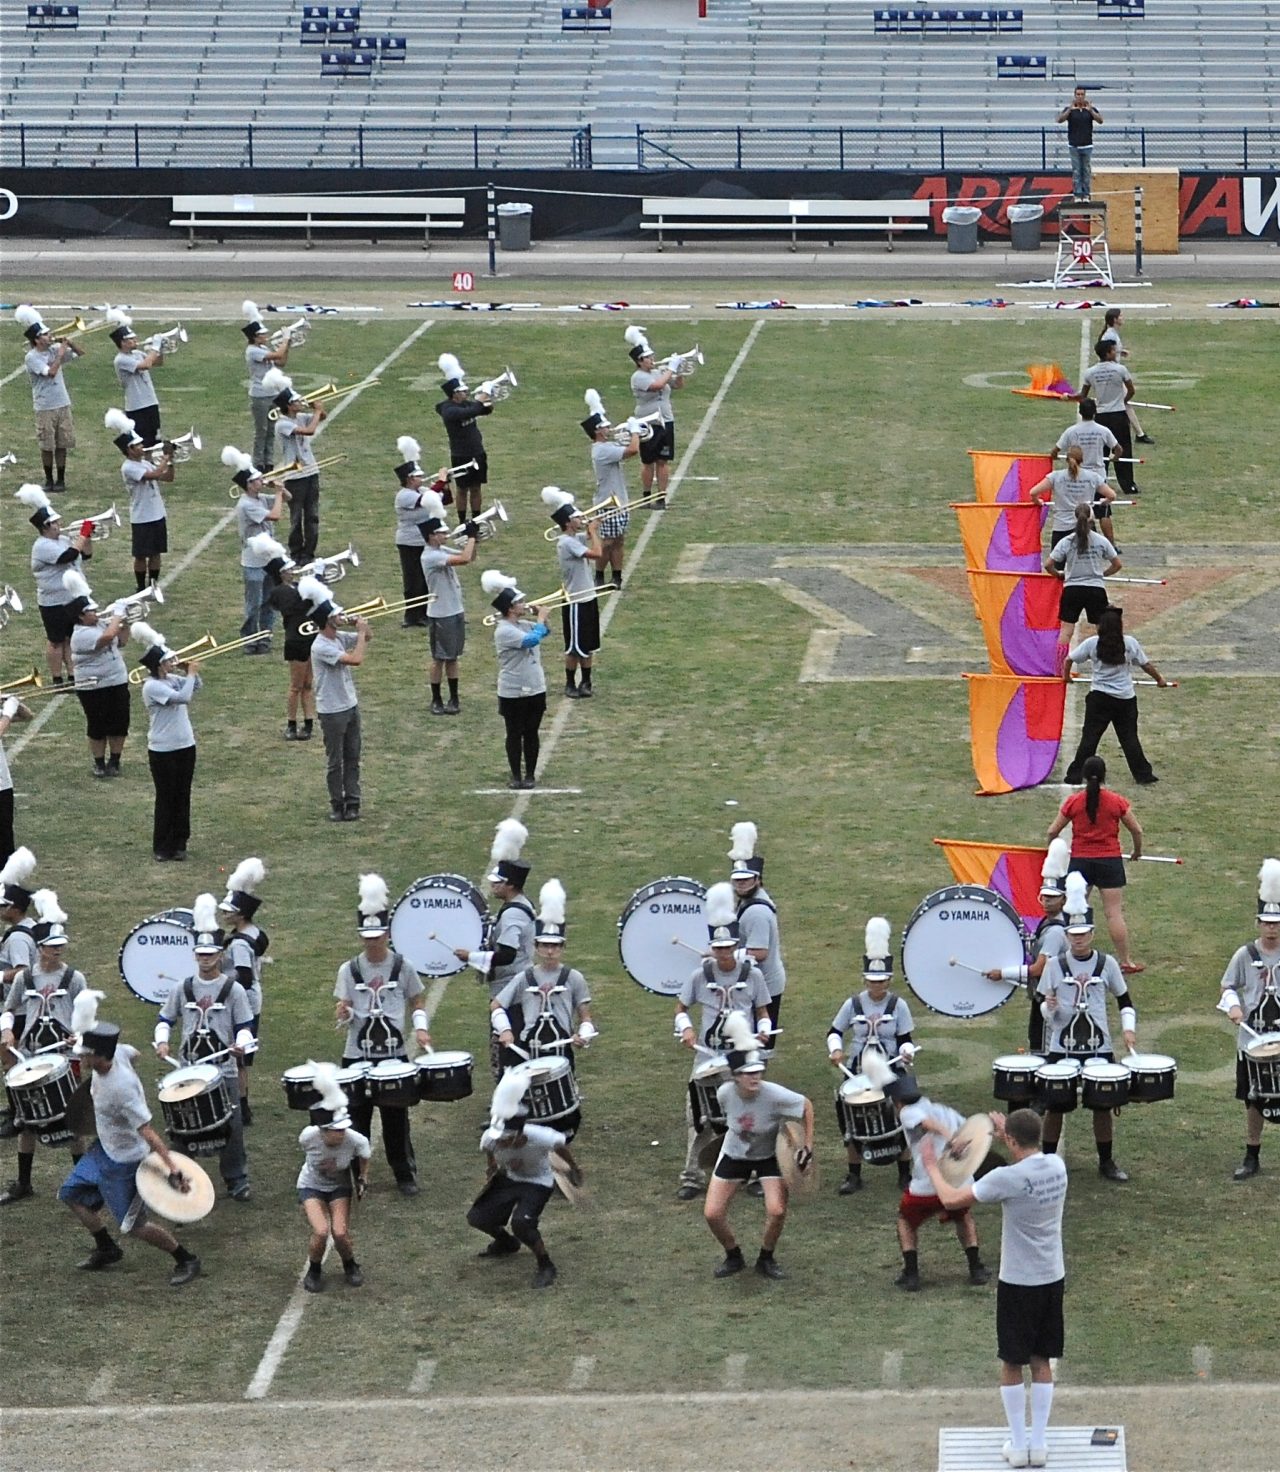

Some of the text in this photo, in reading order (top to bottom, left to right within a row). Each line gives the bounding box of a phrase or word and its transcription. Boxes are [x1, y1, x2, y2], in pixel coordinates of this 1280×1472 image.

[889, 177, 1242, 235] ARIZA
[1073, 240, 1091, 257] 50
[453, 272, 472, 290] 40
[422, 898, 462, 909] YAMAHA
[661, 903, 702, 914] YAMAHA
[950, 910, 990, 921] YAMAHA
[149, 935, 189, 946] YAMAHA
